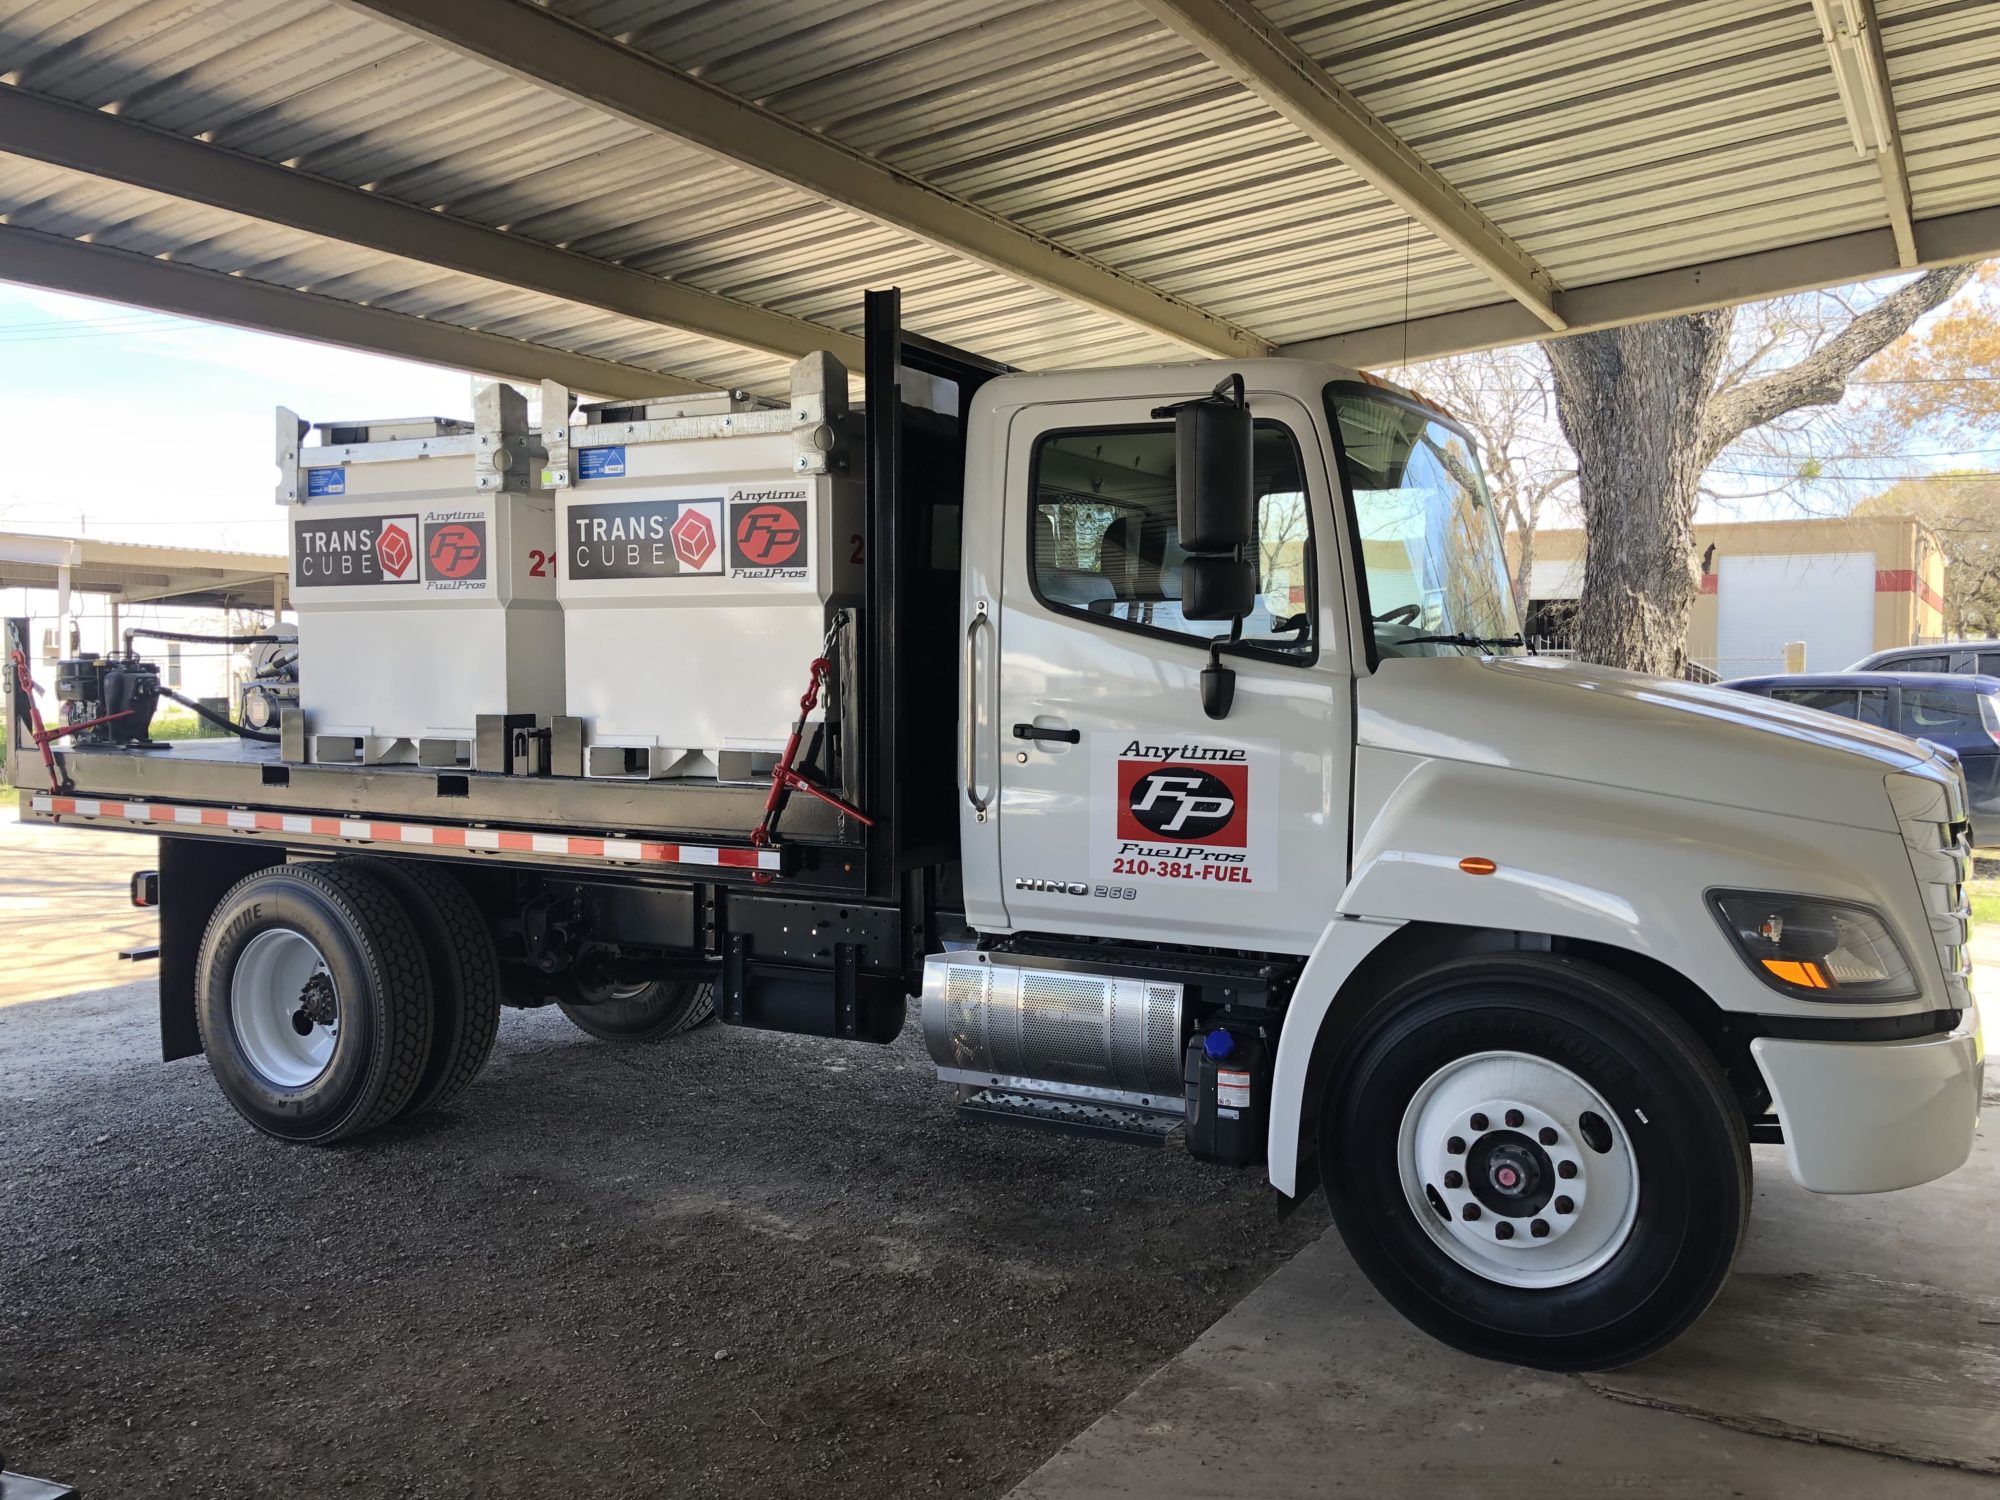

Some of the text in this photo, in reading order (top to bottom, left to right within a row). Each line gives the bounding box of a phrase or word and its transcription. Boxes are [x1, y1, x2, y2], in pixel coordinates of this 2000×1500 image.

[730, 490, 806, 502] Anytime
[424, 511, 485, 522] Anytime
[576, 515, 664, 542] TRANS
[302, 529, 371, 553] TRANS
[302, 555, 372, 576] CUBE
[576, 544, 665, 567] CUBE
[1120, 741, 1247, 762] Anytime
[1131, 775, 1235, 831] FP
[1117, 843, 1246, 863] FuelPros
[1112, 858, 1252, 884] 210-381-FUEL
[1015, 877, 1137, 900] HINO 268
